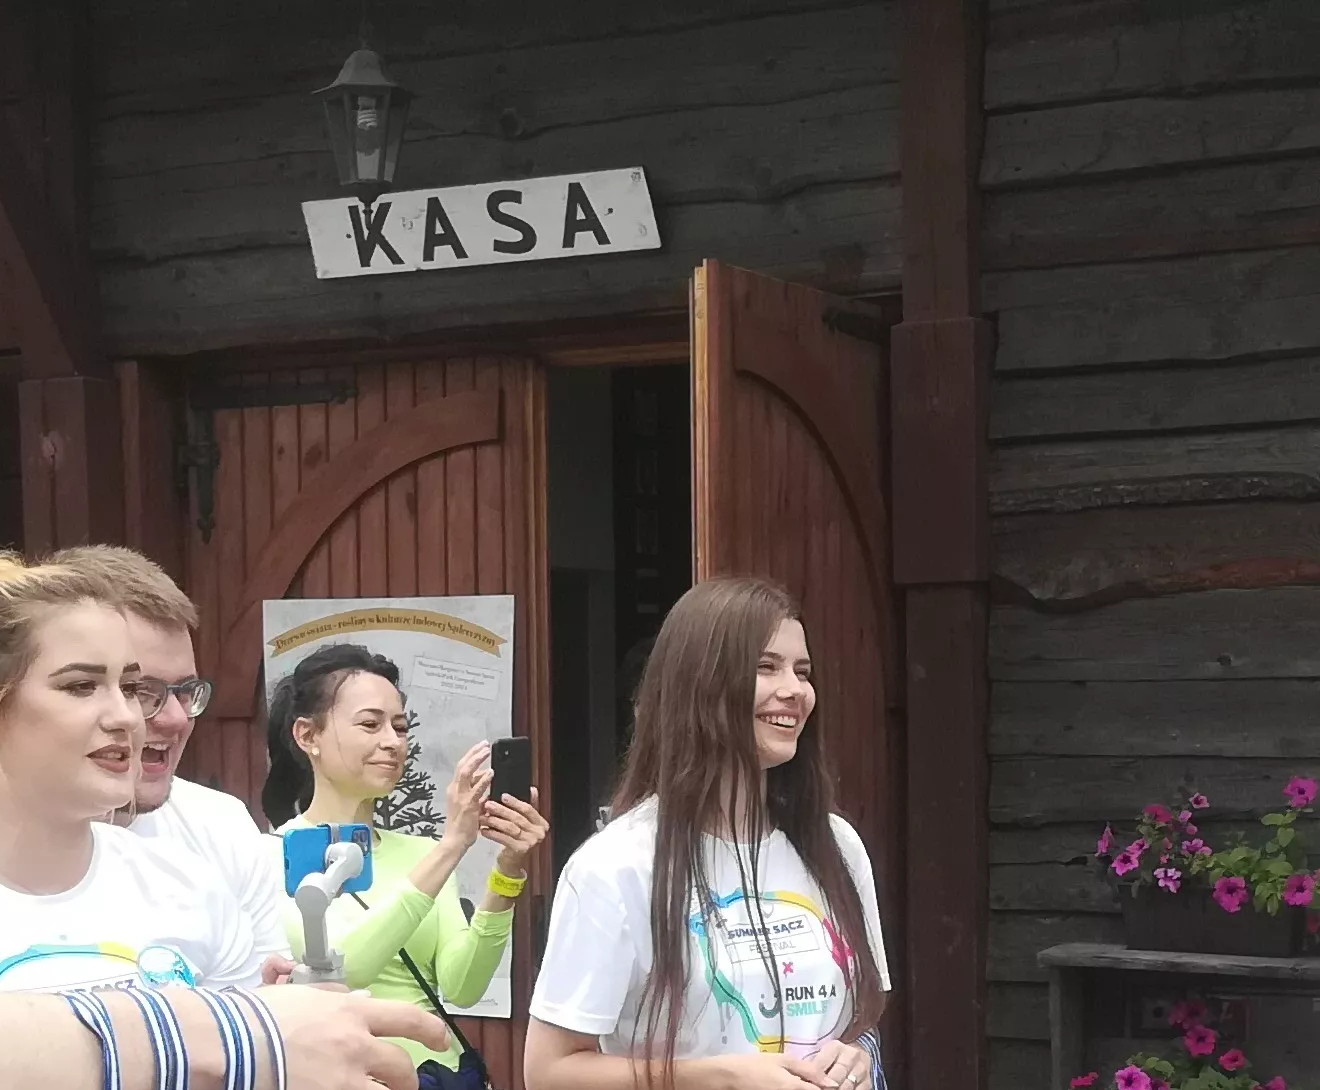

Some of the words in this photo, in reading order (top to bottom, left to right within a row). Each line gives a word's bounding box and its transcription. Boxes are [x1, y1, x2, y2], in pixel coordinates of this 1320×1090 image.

[347, 181, 611, 268] KASA
[413, 615, 446, 632] ludowej
[772, 919, 804, 934] SĄCZ
[785, 985, 814, 1001] RUN
[818, 984, 827, 998] 4
[786, 1000, 829, 1017] SMILE
